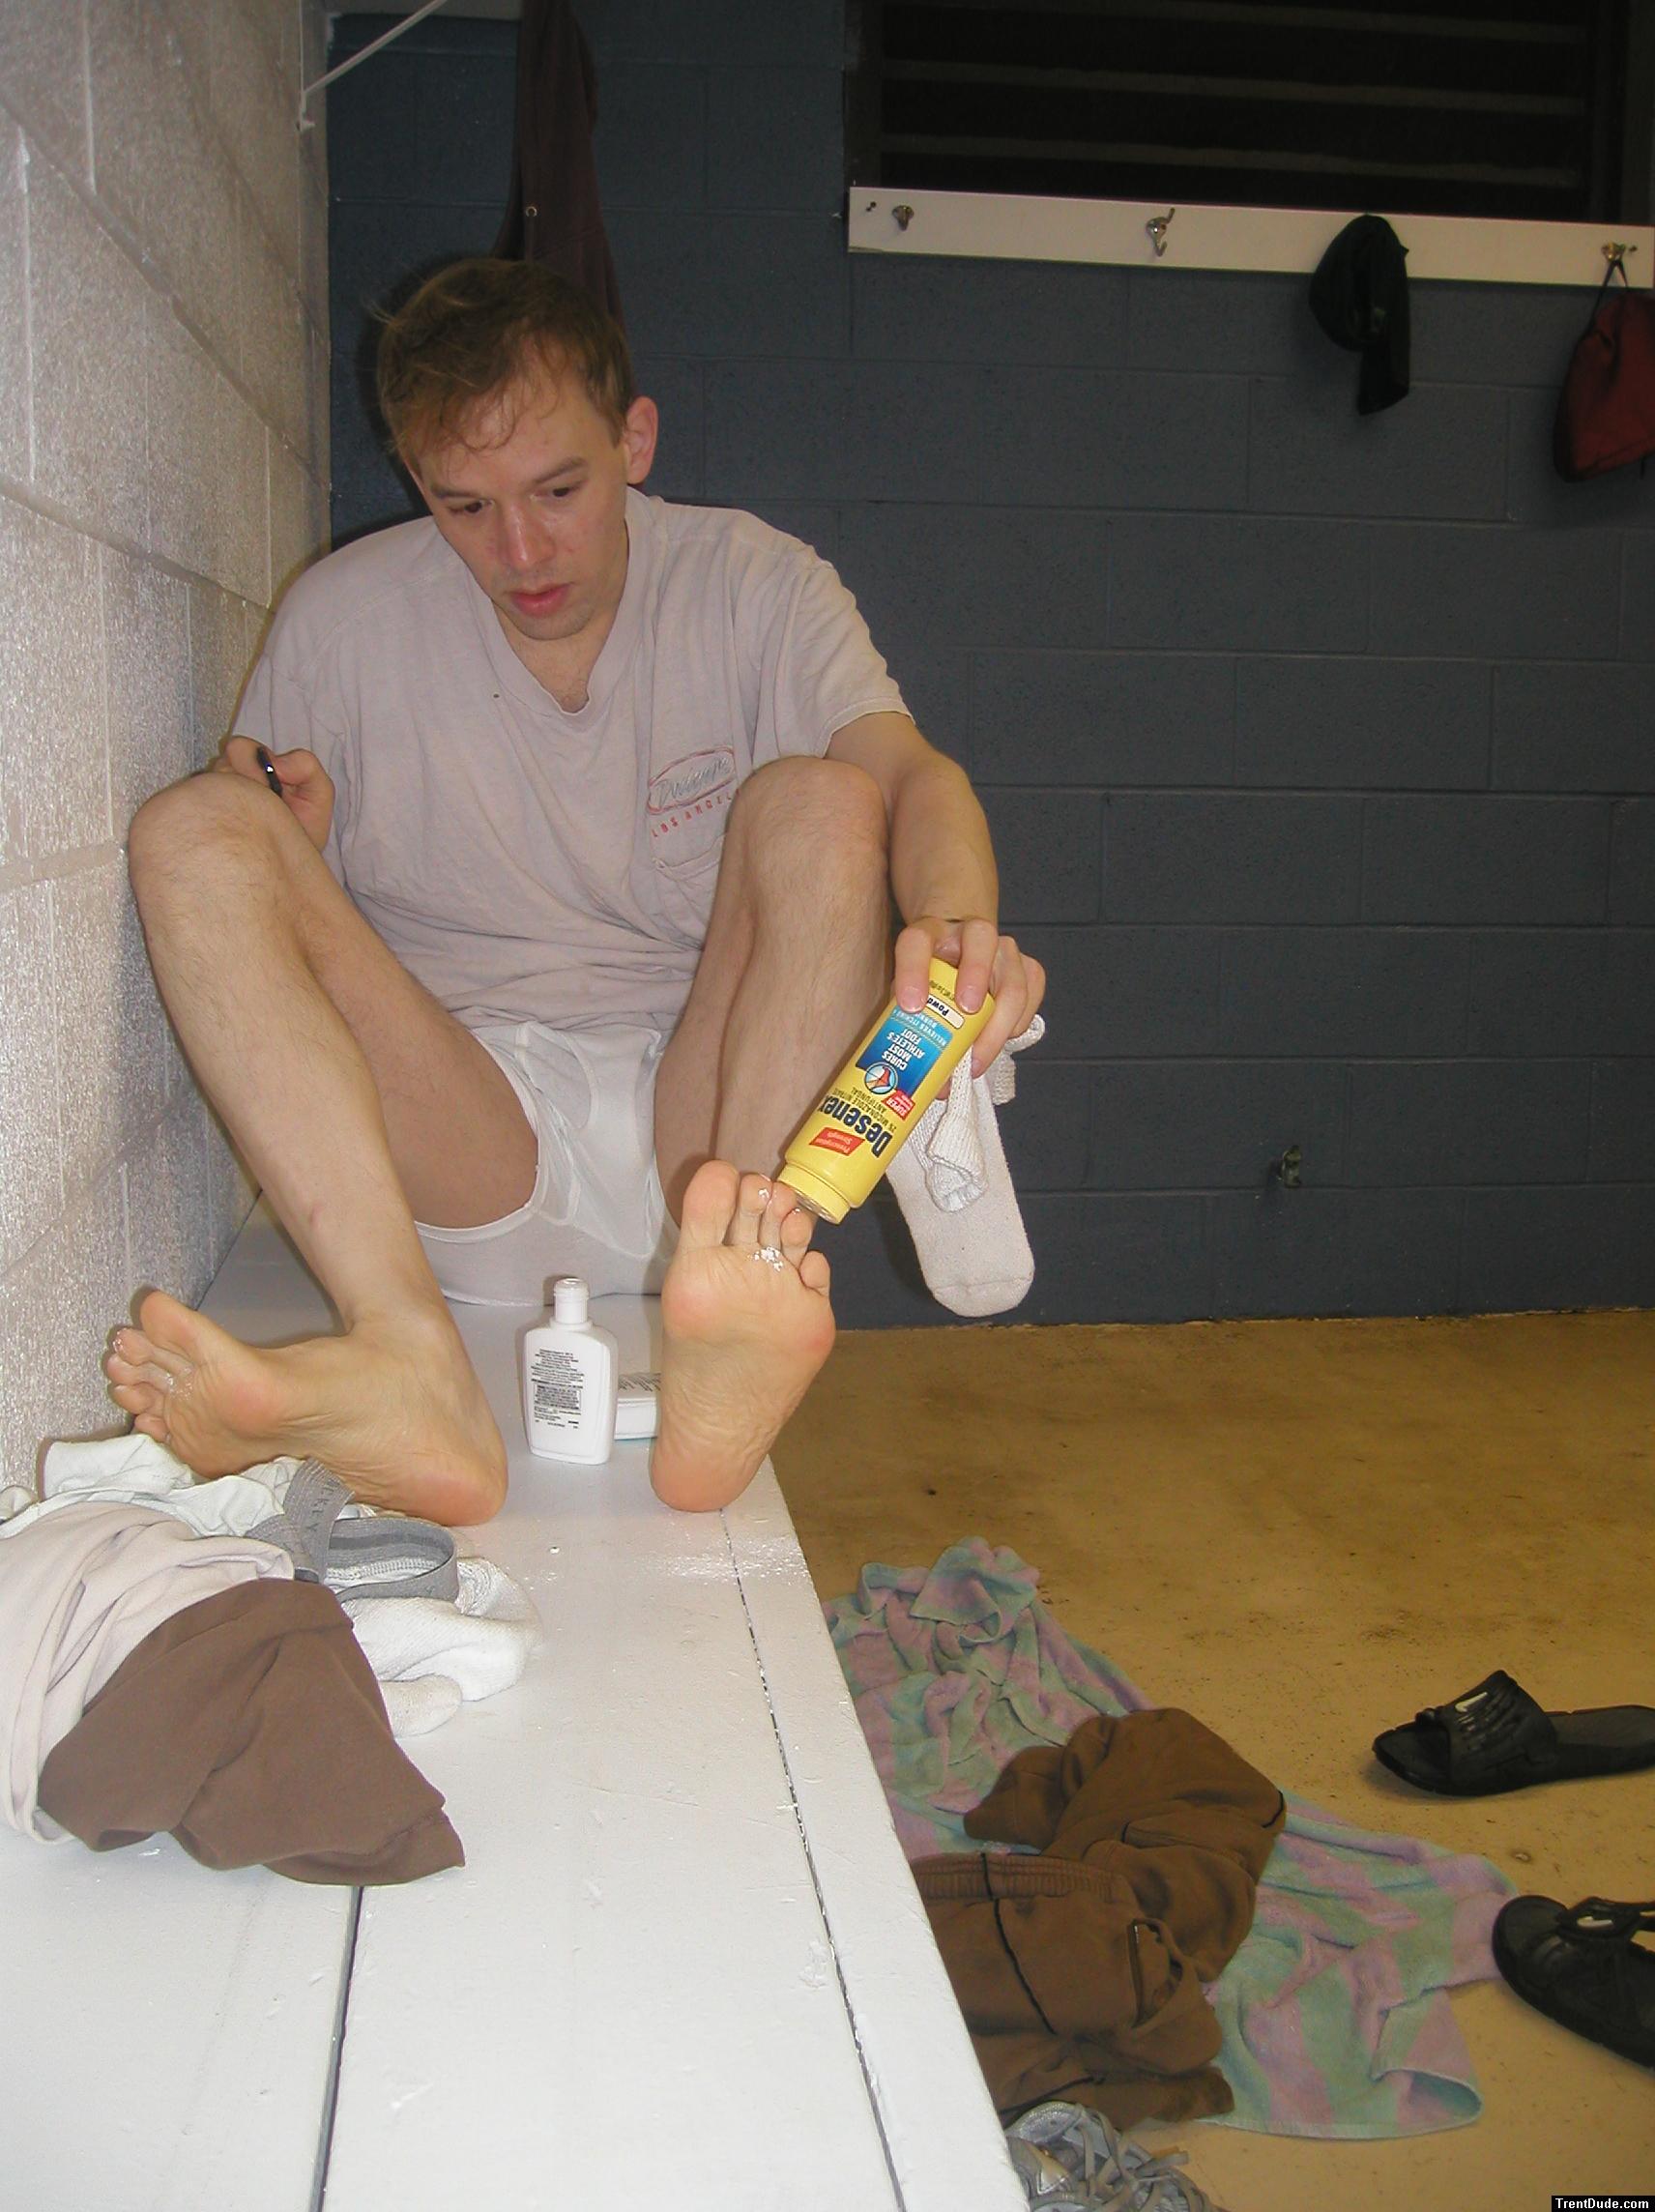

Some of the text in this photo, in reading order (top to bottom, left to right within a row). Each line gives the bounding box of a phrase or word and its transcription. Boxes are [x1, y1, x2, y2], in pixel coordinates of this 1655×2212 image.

[652, 817, 679, 837] LOS
[927, 997, 949, 1016] Powd
[886, 1030, 925, 1059] ATHLETE'S
[901, 1027, 921, 1045] FOOT
[919, 1023, 946, 1046] RELIEVES
[881, 1049, 908, 1070] CURES
[887, 1042, 912, 1062] MOST
[850, 1087, 886, 1113] ANTIFUNGAL
[851, 1096, 889, 1125] MICONAZOLE
[886, 1096, 907, 1116] SUPER
[820, 1094, 893, 1158] Desenex
